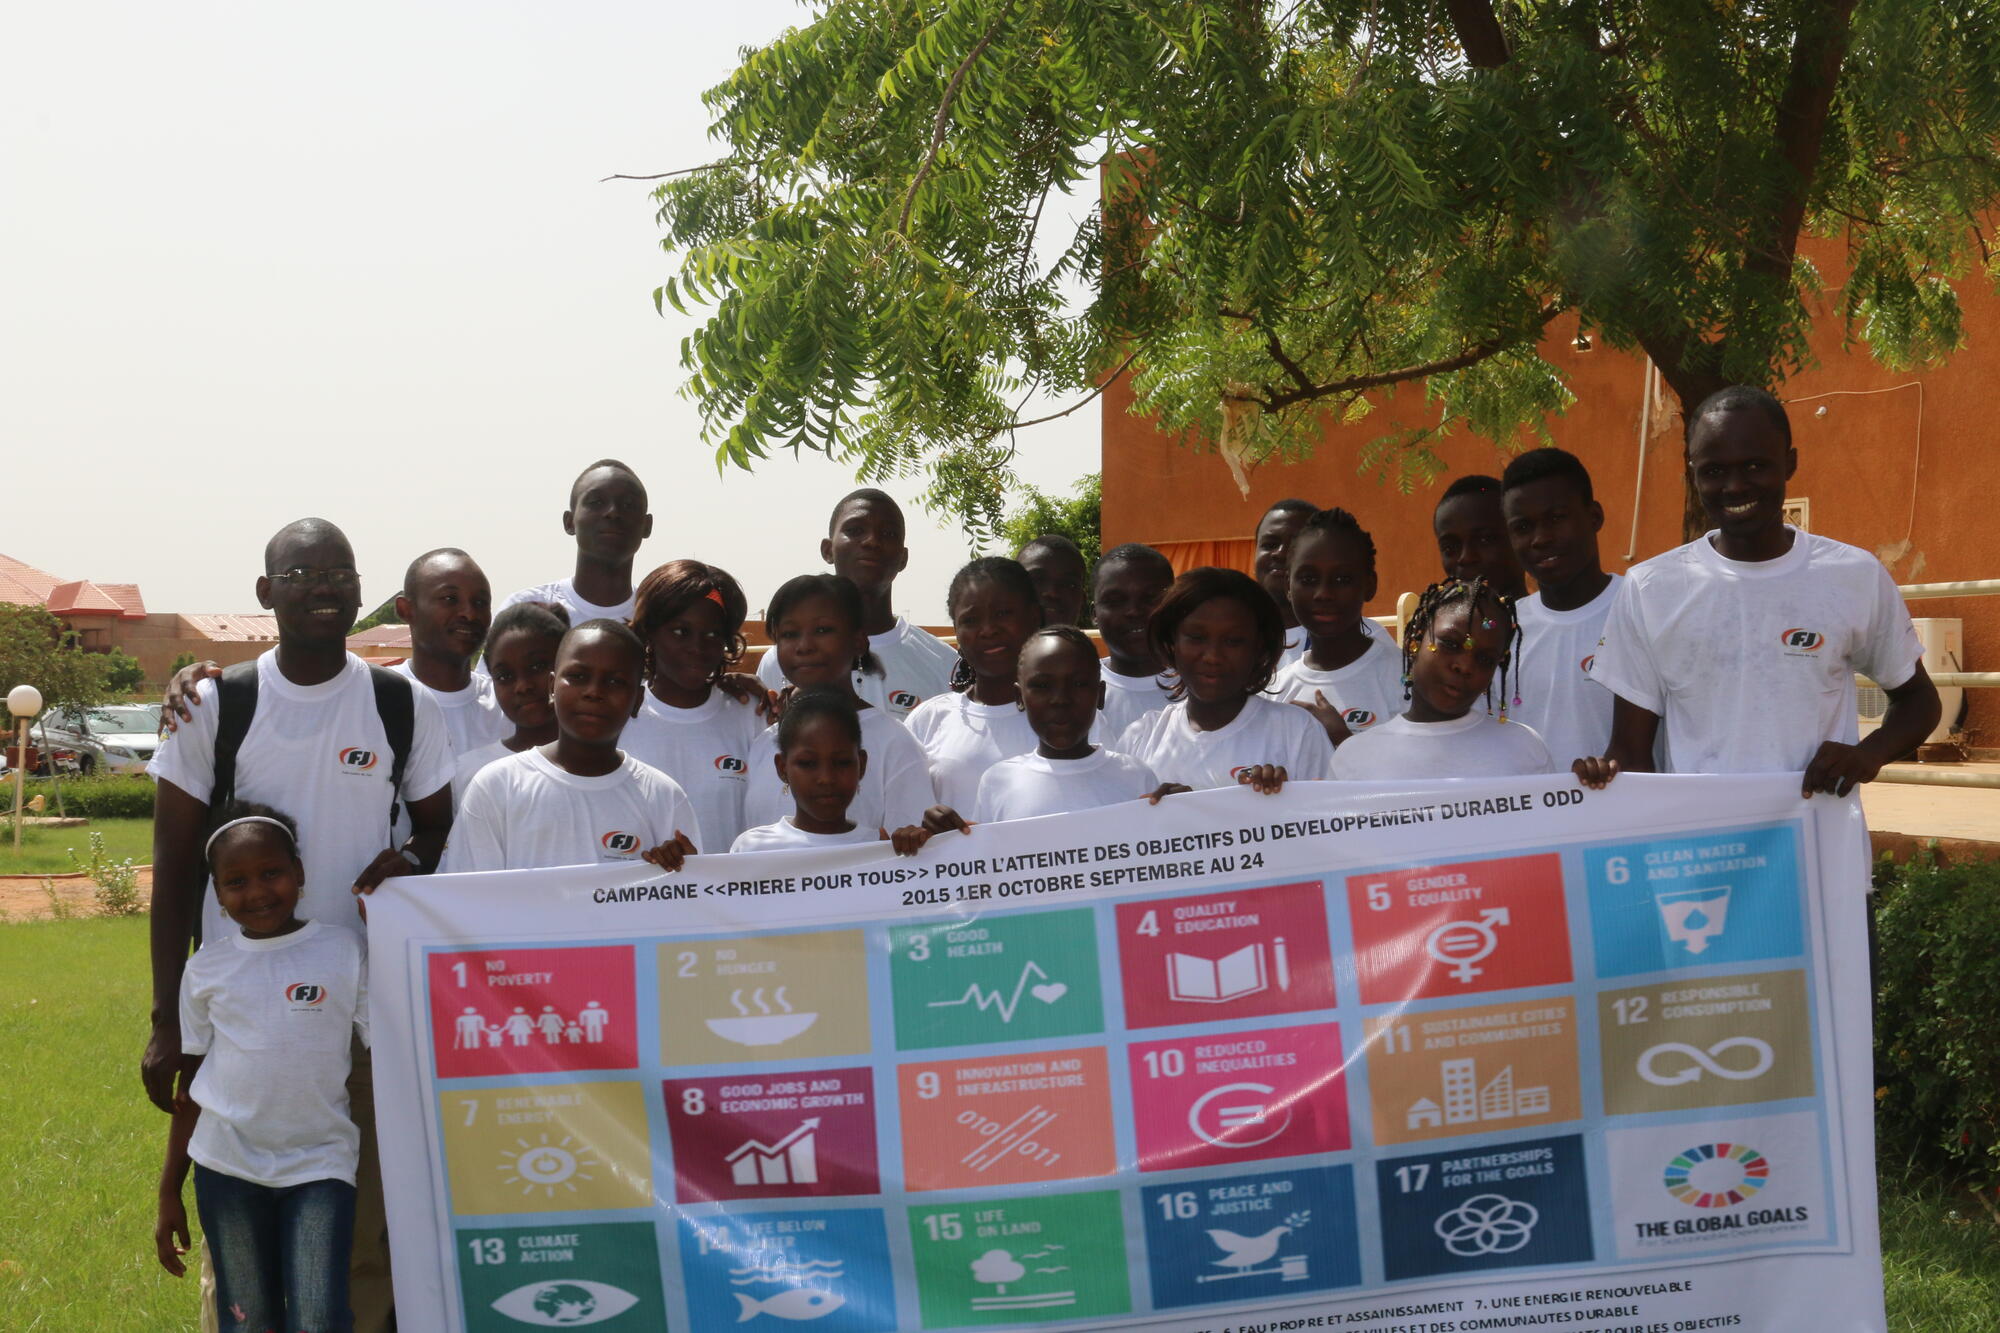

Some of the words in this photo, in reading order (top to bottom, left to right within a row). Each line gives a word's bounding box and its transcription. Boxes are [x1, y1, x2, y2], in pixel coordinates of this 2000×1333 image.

[1790, 631, 1816, 648] FJ
[1347, 710, 1369, 724] FJ
[347, 750, 371, 766] FJ
[592, 882, 698, 904] CAMPAGNE
[801, 873, 852, 893] POUR
[935, 858, 987, 880] POUR
[992, 847, 1089, 873] L'ATTEINTE
[1094, 842, 1131, 862] DES
[1136, 830, 1234, 857] OBJECTIFS
[1239, 825, 1266, 846] DU
[1271, 803, 1435, 841] DEVELOPPEMENT
[1441, 793, 1533, 821] DURABLE
[1543, 788, 1585, 808] ODD
[610, 834, 634, 850] FJ
[1644, 848, 1693, 866] CLEAN
[1697, 843, 1747, 859] WATER
[902, 886, 950, 907] 2015
[954, 883, 993, 903] 1ER
[998, 873, 1086, 898] OCTOBRE
[1089, 859, 1205, 887] SEPTEMBRE
[1210, 855, 1236, 874] AU
[1240, 851, 1266, 871] 24
[1606, 856, 1630, 884] 6
[1648, 863, 1680, 880] AND
[1683, 856, 1767, 877] SANITATION
[1407, 873, 1467, 892] GENDER
[1367, 882, 1391, 911] 5
[1408, 886, 1483, 907] EQUALITY
[1172, 901, 1237, 920] QUALITY
[1136, 910, 1160, 937] 4
[1175, 914, 1259, 934] EDUCATION
[908, 934, 930, 961] 3
[946, 928, 989, 944] GOOD
[947, 941, 1003, 958] HEALTH
[451, 961, 467, 988] 1
[485, 959, 506, 972] NO
[676, 951, 700, 979] 2
[487, 972, 553, 987] POVERTY
[295, 985, 318, 1001] FJ
[1660, 983, 1761, 1005] RESPONSIBLE
[1521, 1006, 1567, 1023] CITIES
[1611, 995, 1649, 1026] 12
[1661, 998, 1772, 1020] CONSUMPTION
[1380, 1025, 1413, 1055] 11
[1424, 1034, 1456, 1050] AND
[1458, 1022, 1562, 1046] COMMUNITIES
[1194, 1040, 1267, 1059] REDUCED
[955, 1061, 1046, 1082] INNOVATION
[1049, 1057, 1082, 1073] AND
[1143, 1049, 1185, 1079] 10
[1196, 1052, 1297, 1074] INEQUALITIES
[719, 1084, 763, 1099] GOOD
[766, 1081, 807, 1096] JOBS
[810, 1079, 842, 1092] AND
[915, 1071, 941, 1100] 9
[955, 1074, 1086, 1097] INFRASTRUCTURE
[682, 1087, 706, 1115] 8
[720, 1097, 798, 1114] ECONOMIC
[801, 1093, 865, 1108] GROWTH
[460, 1100, 480, 1127] 7
[1441, 1148, 1553, 1173] PARTNERSHIPS
[1394, 1164, 1431, 1193] 17
[1442, 1172, 1472, 1188] FOR
[1476, 1168, 1502, 1184] THE
[1505, 1162, 1554, 1180] GOALS
[1209, 1184, 1256, 1201] PEACE
[1260, 1180, 1293, 1196] AND
[975, 1209, 1006, 1223] LIFE
[1157, 1191, 1199, 1221] 16
[1211, 1198, 1273, 1216] JUSTICE
[777, 1220, 826, 1234] BELOW
[923, 1213, 963, 1241] 15
[976, 1223, 999, 1238] ON
[1002, 1221, 1041, 1236] LAND
[1636, 1220, 1670, 1238] THE
[1673, 1213, 1744, 1236] GLOBAL
[1747, 1206, 1808, 1226] GOALS
[469, 1237, 506, 1265] 13
[518, 1234, 580, 1248] CLIMATE
[521, 1249, 574, 1263] ACTION
[1270, 1316, 1324, 1333] PROPRE
[1328, 1314, 1342, 1325] ET
[1346, 1301, 1464, 1323] ASSAINISSAMENT
[1491, 1294, 1521, 1310] UNE
[1524, 1290, 1583, 1306] ENERGIE
[1586, 1280, 1693, 1301] RENOUVELABLE
[1431, 1320, 1455, 1333] DES
[1459, 1310, 1572, 1332] COMMUNAUTES
[1575, 1305, 1639, 1321] DURABLE
